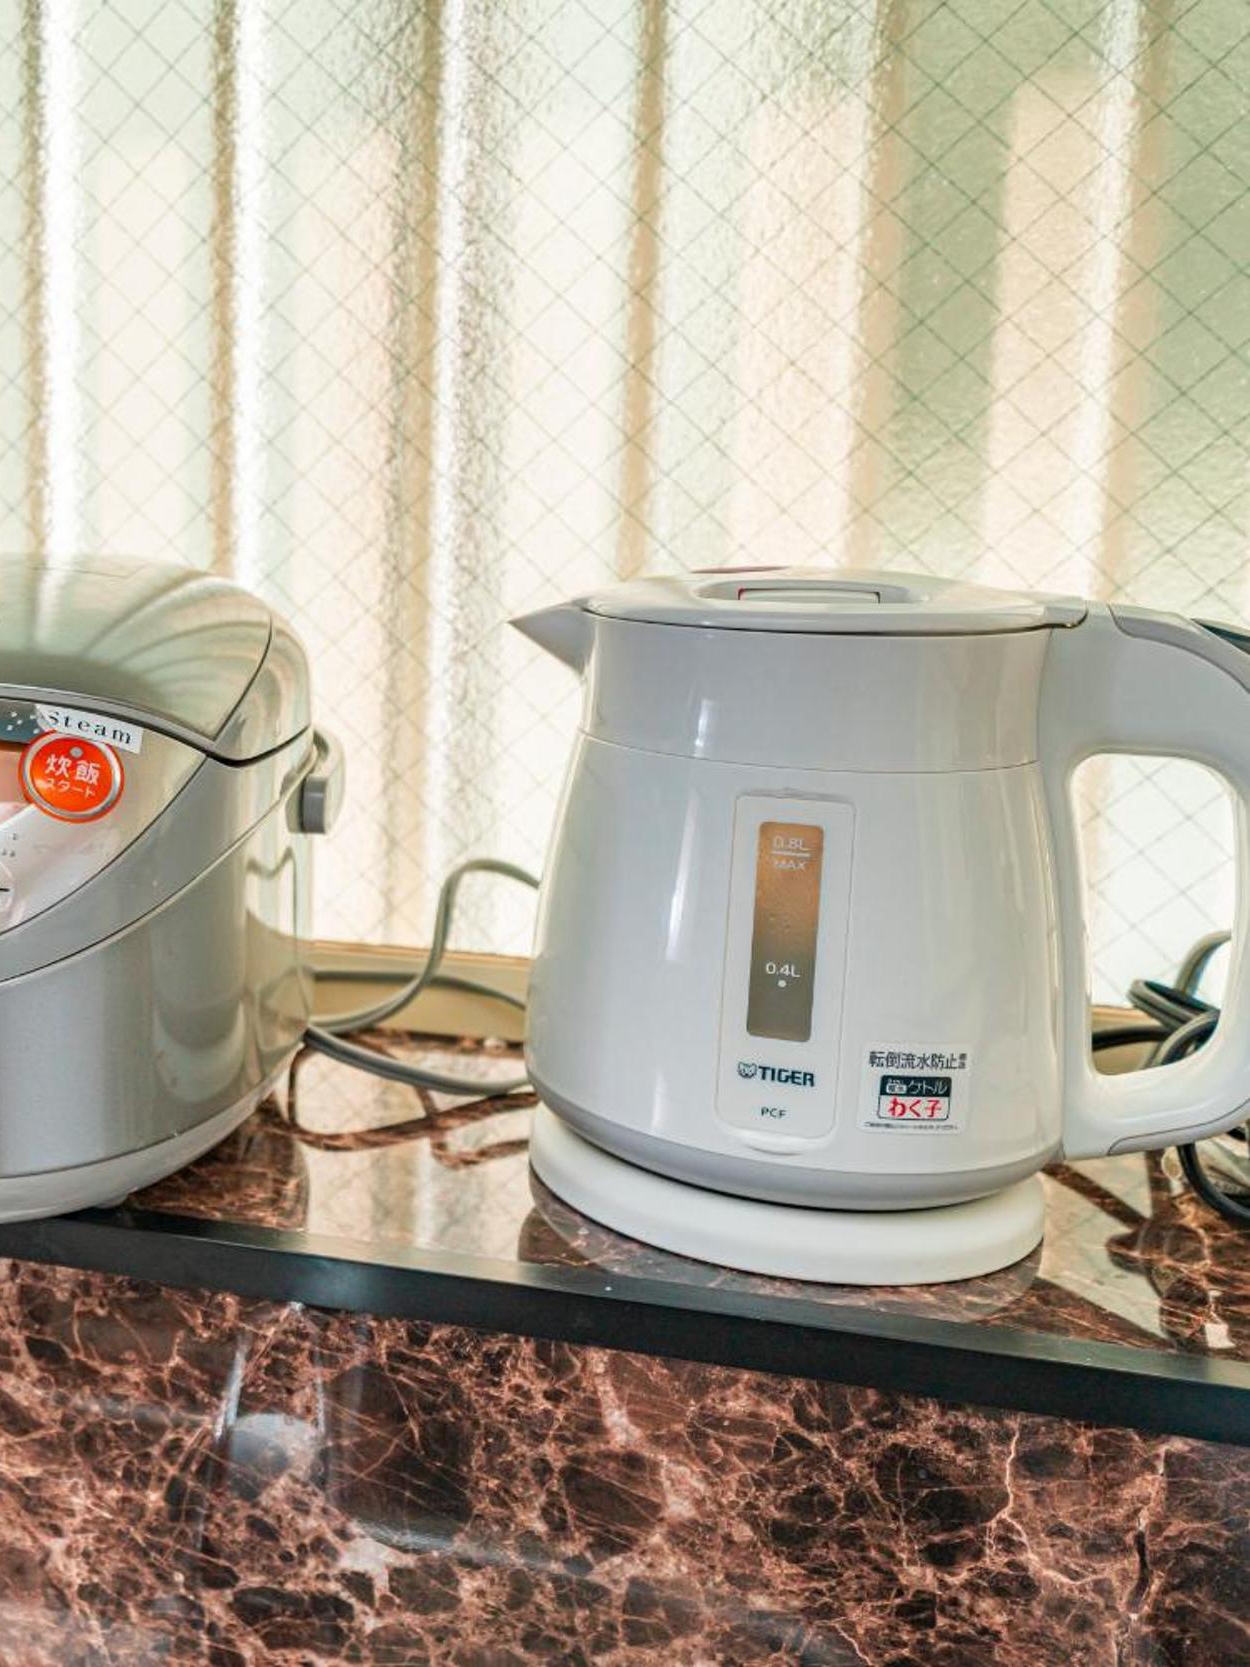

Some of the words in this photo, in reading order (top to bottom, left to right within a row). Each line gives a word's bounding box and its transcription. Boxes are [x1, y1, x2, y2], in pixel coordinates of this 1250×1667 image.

[49, 711, 131, 744] Steam
[45, 753, 101, 786] 炊飯
[772, 834, 809, 851] 0.8L
[772, 857, 809, 871] MAX
[765, 962, 801, 978] 0.4L
[758, 1065, 815, 1087] TIGER
[760, 1106, 787, 1118] PCF
[888, 1097, 942, 1118] わく子
